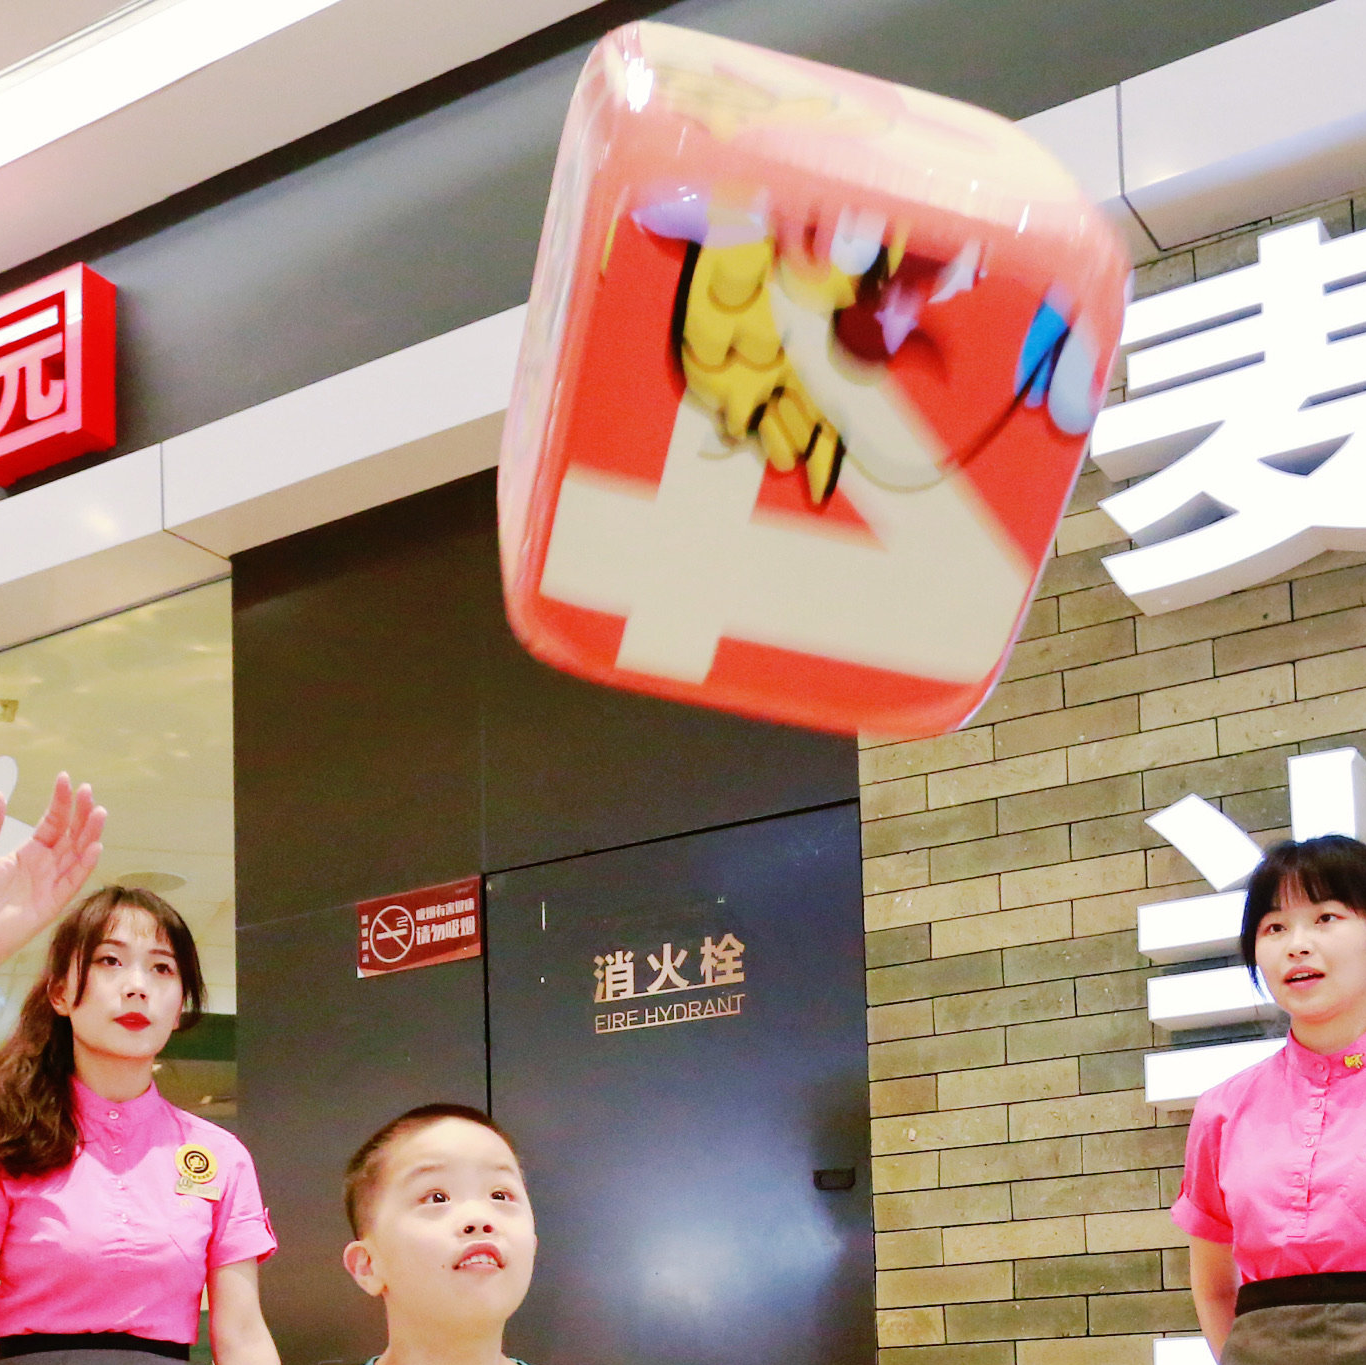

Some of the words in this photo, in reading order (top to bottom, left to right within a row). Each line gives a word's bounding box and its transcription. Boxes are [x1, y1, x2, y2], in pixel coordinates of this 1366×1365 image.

[415, 915, 477, 946] 请勿吸烟
[593, 932, 746, 1003] 消火栓
[595, 1009, 639, 1034] FIRE
[644, 994, 746, 1026] HYDRANT
